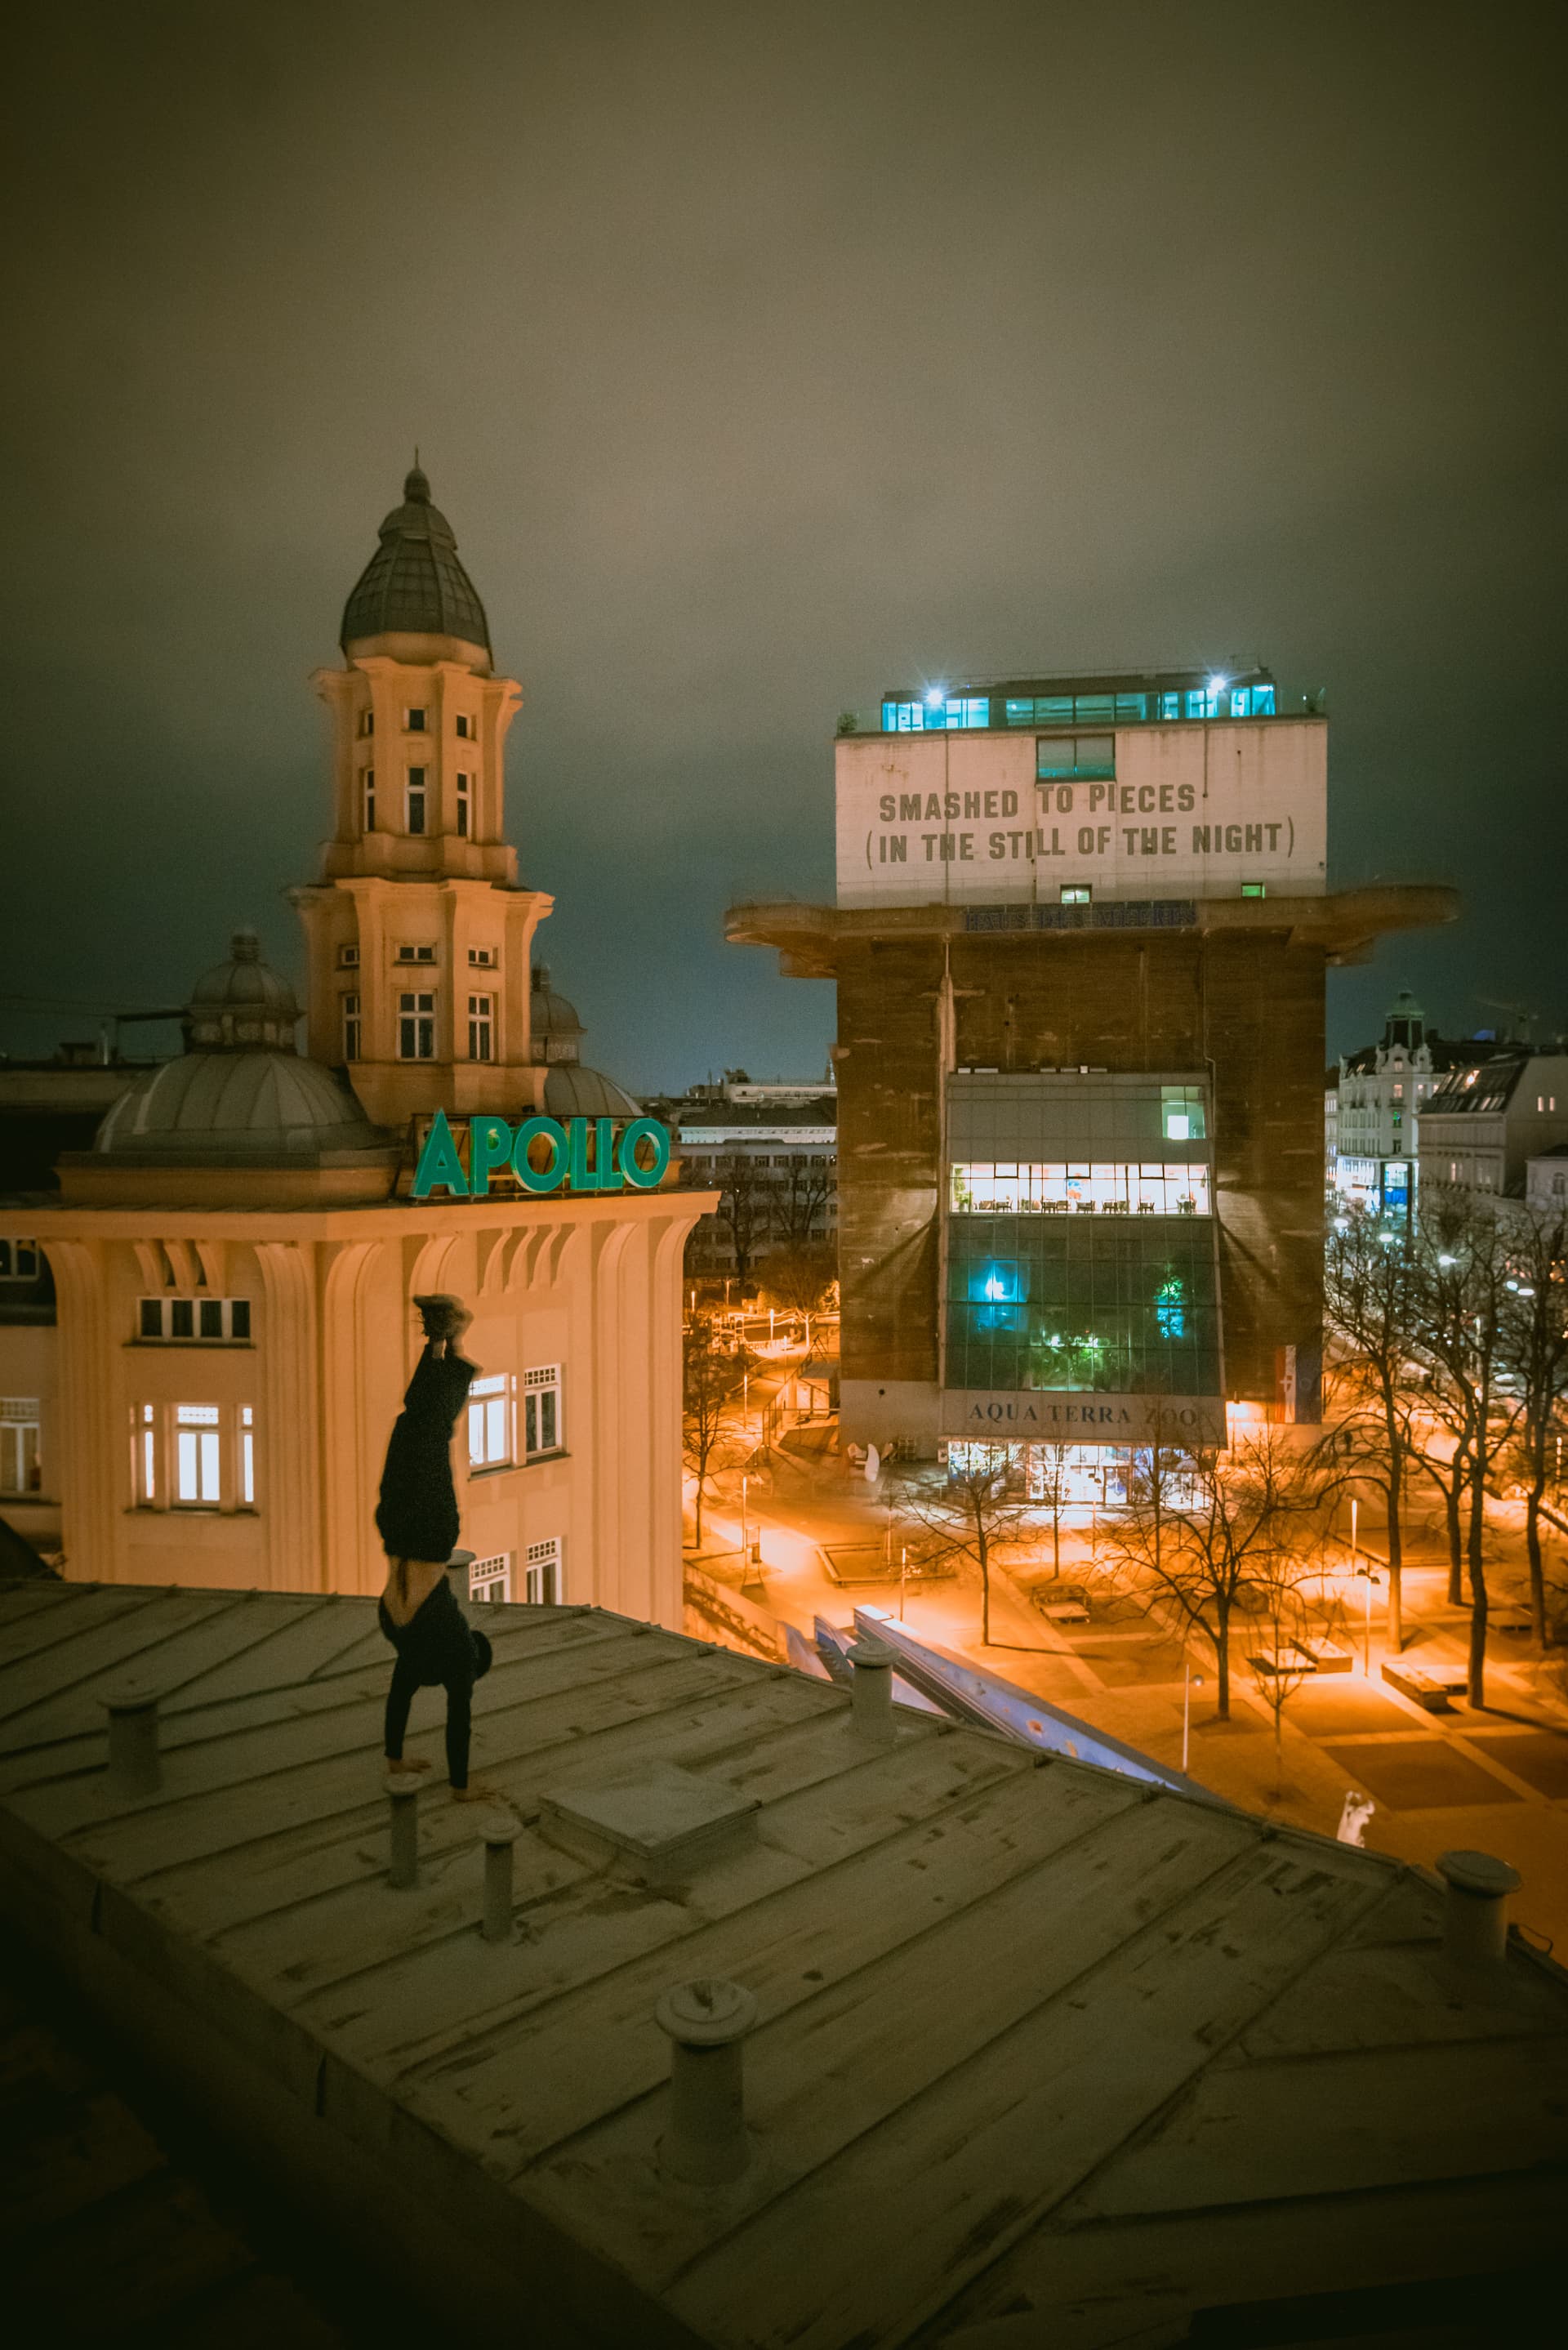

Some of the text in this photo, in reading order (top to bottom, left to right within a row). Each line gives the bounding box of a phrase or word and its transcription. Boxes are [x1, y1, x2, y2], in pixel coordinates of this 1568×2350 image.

[880, 783, 1196, 822] SMASHED TO PIECES
[866, 817, 1294, 869] (IN THE STILL OF THE NIGHT)
[412, 1108, 670, 1197] APOLLO
[969, 1402, 1197, 1426] AQUA TERRA ZOO
